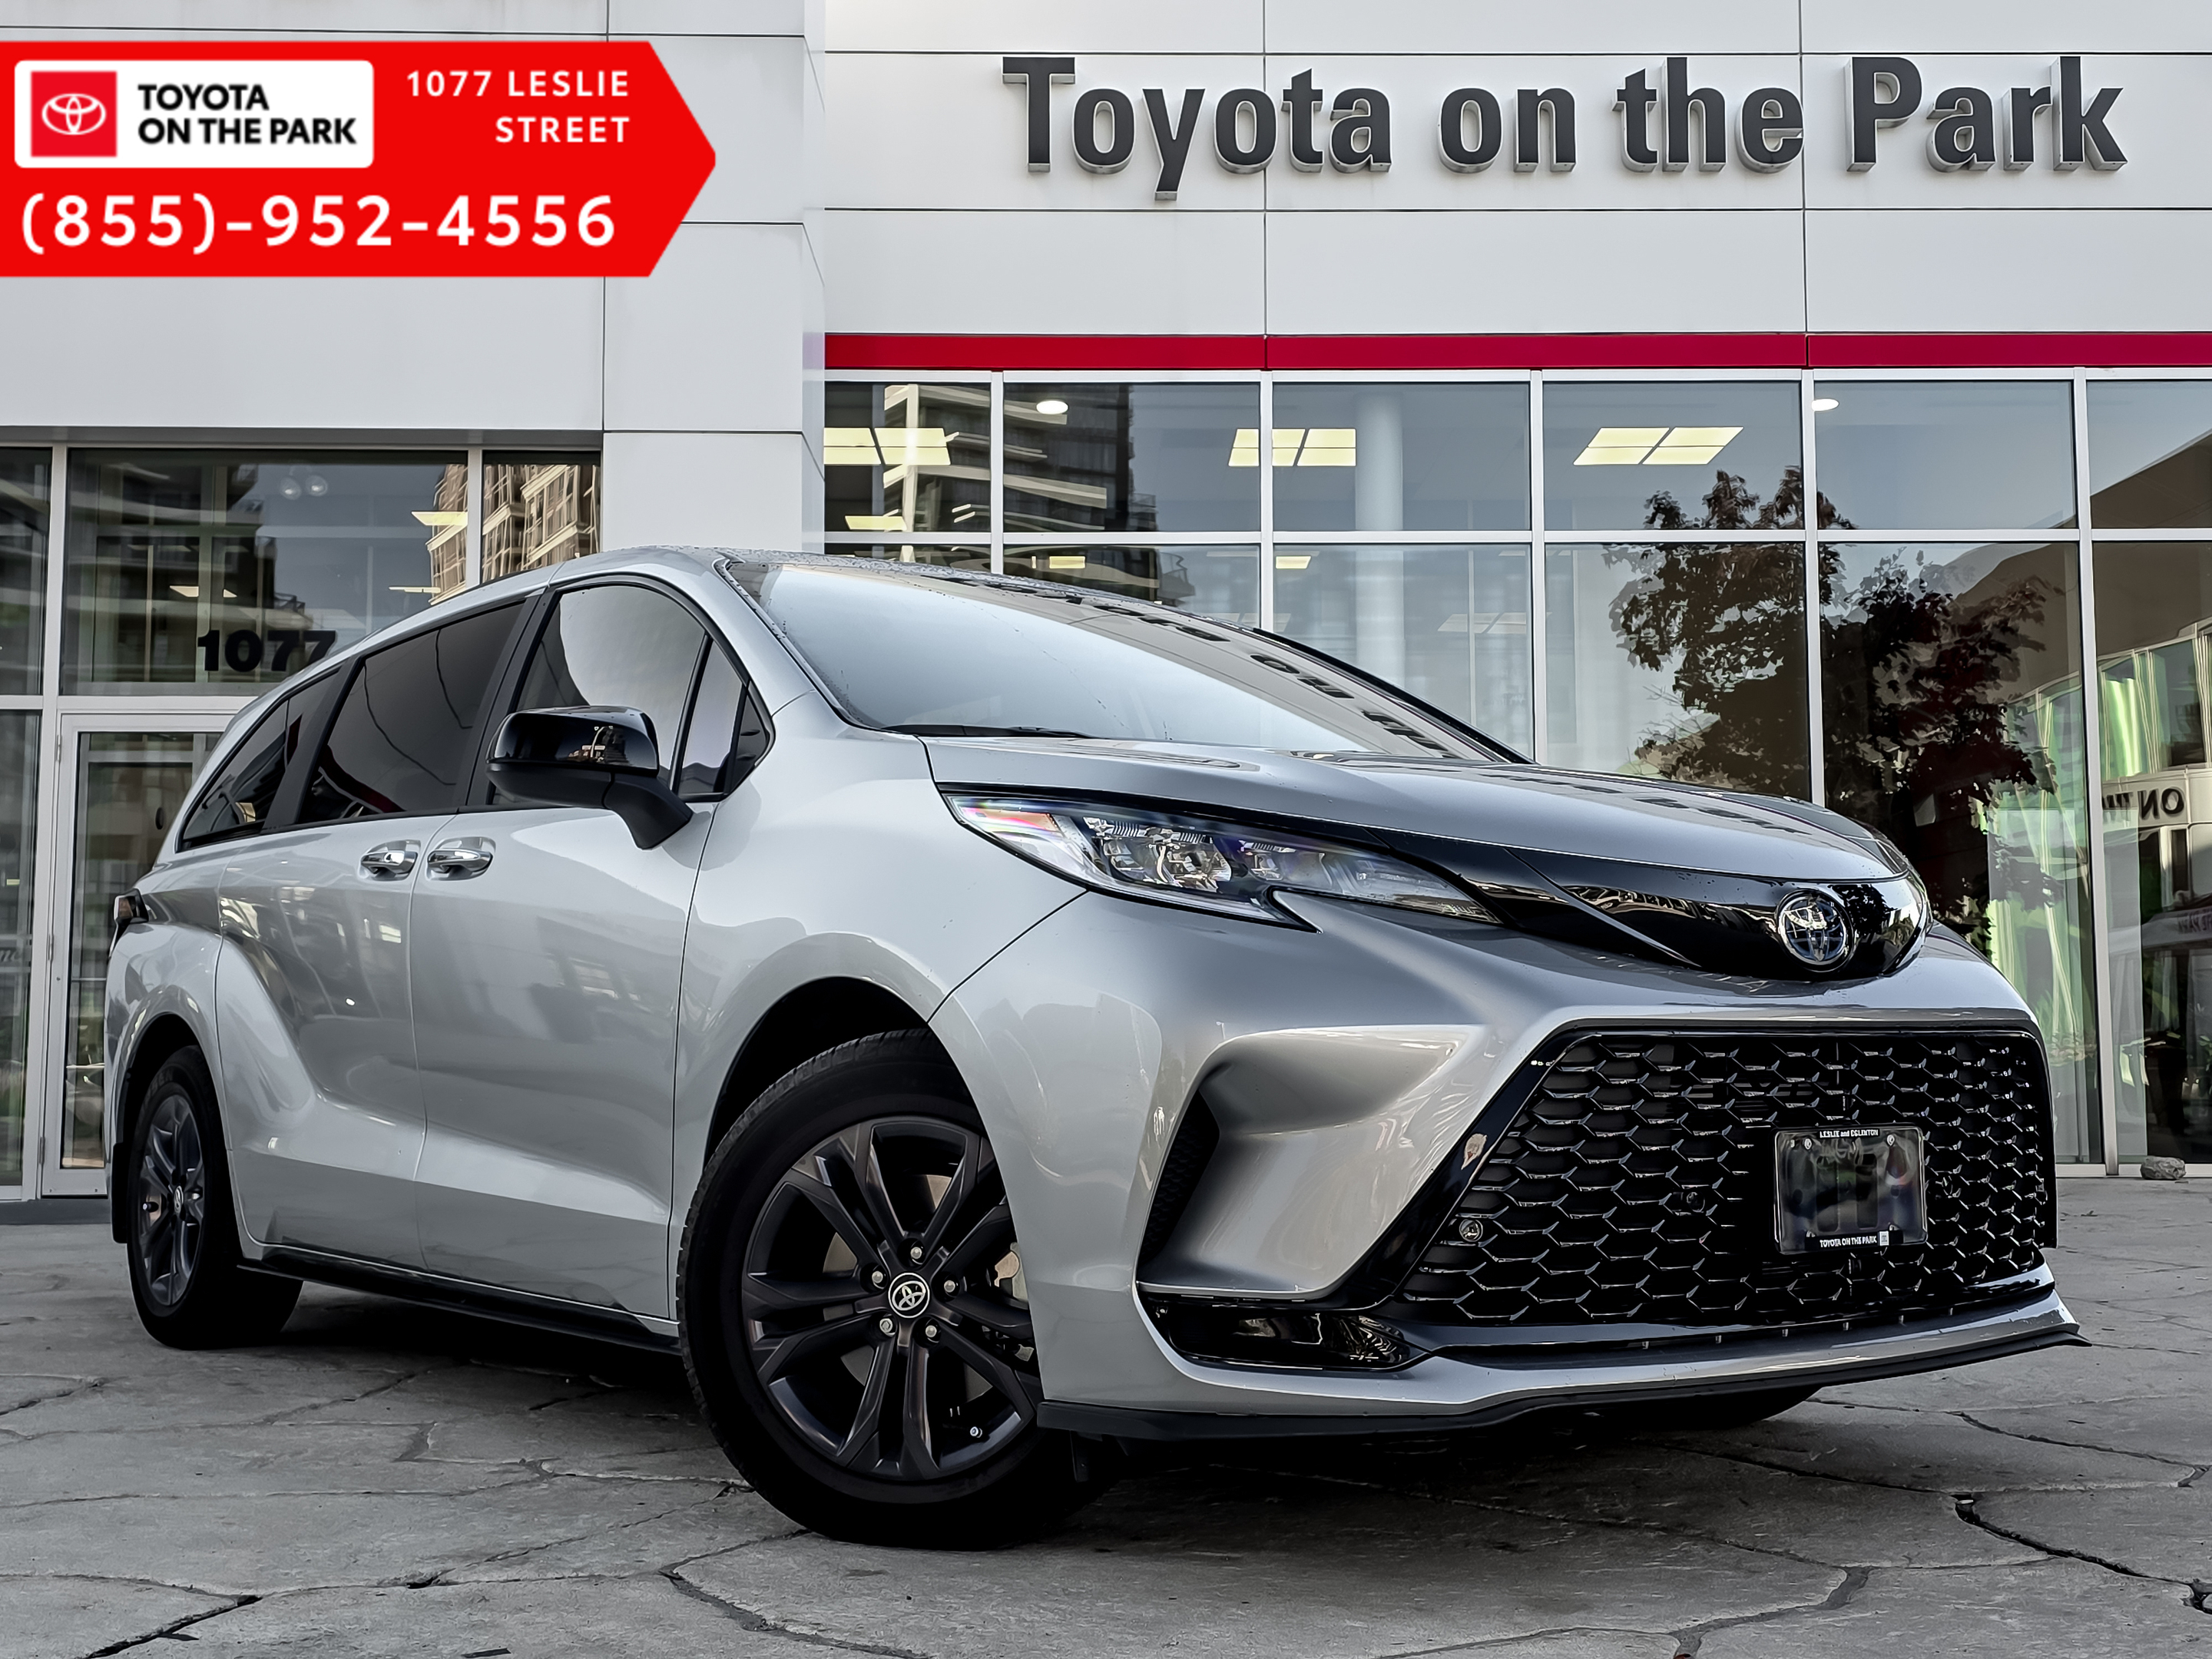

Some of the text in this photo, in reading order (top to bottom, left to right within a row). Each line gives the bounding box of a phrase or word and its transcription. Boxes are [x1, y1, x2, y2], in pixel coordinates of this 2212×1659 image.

[1002, 56, 2128, 200] Toyota on the Park
[197, 629, 336, 672] 1077
[1820, 1238, 1841, 1247] TOYOTA
